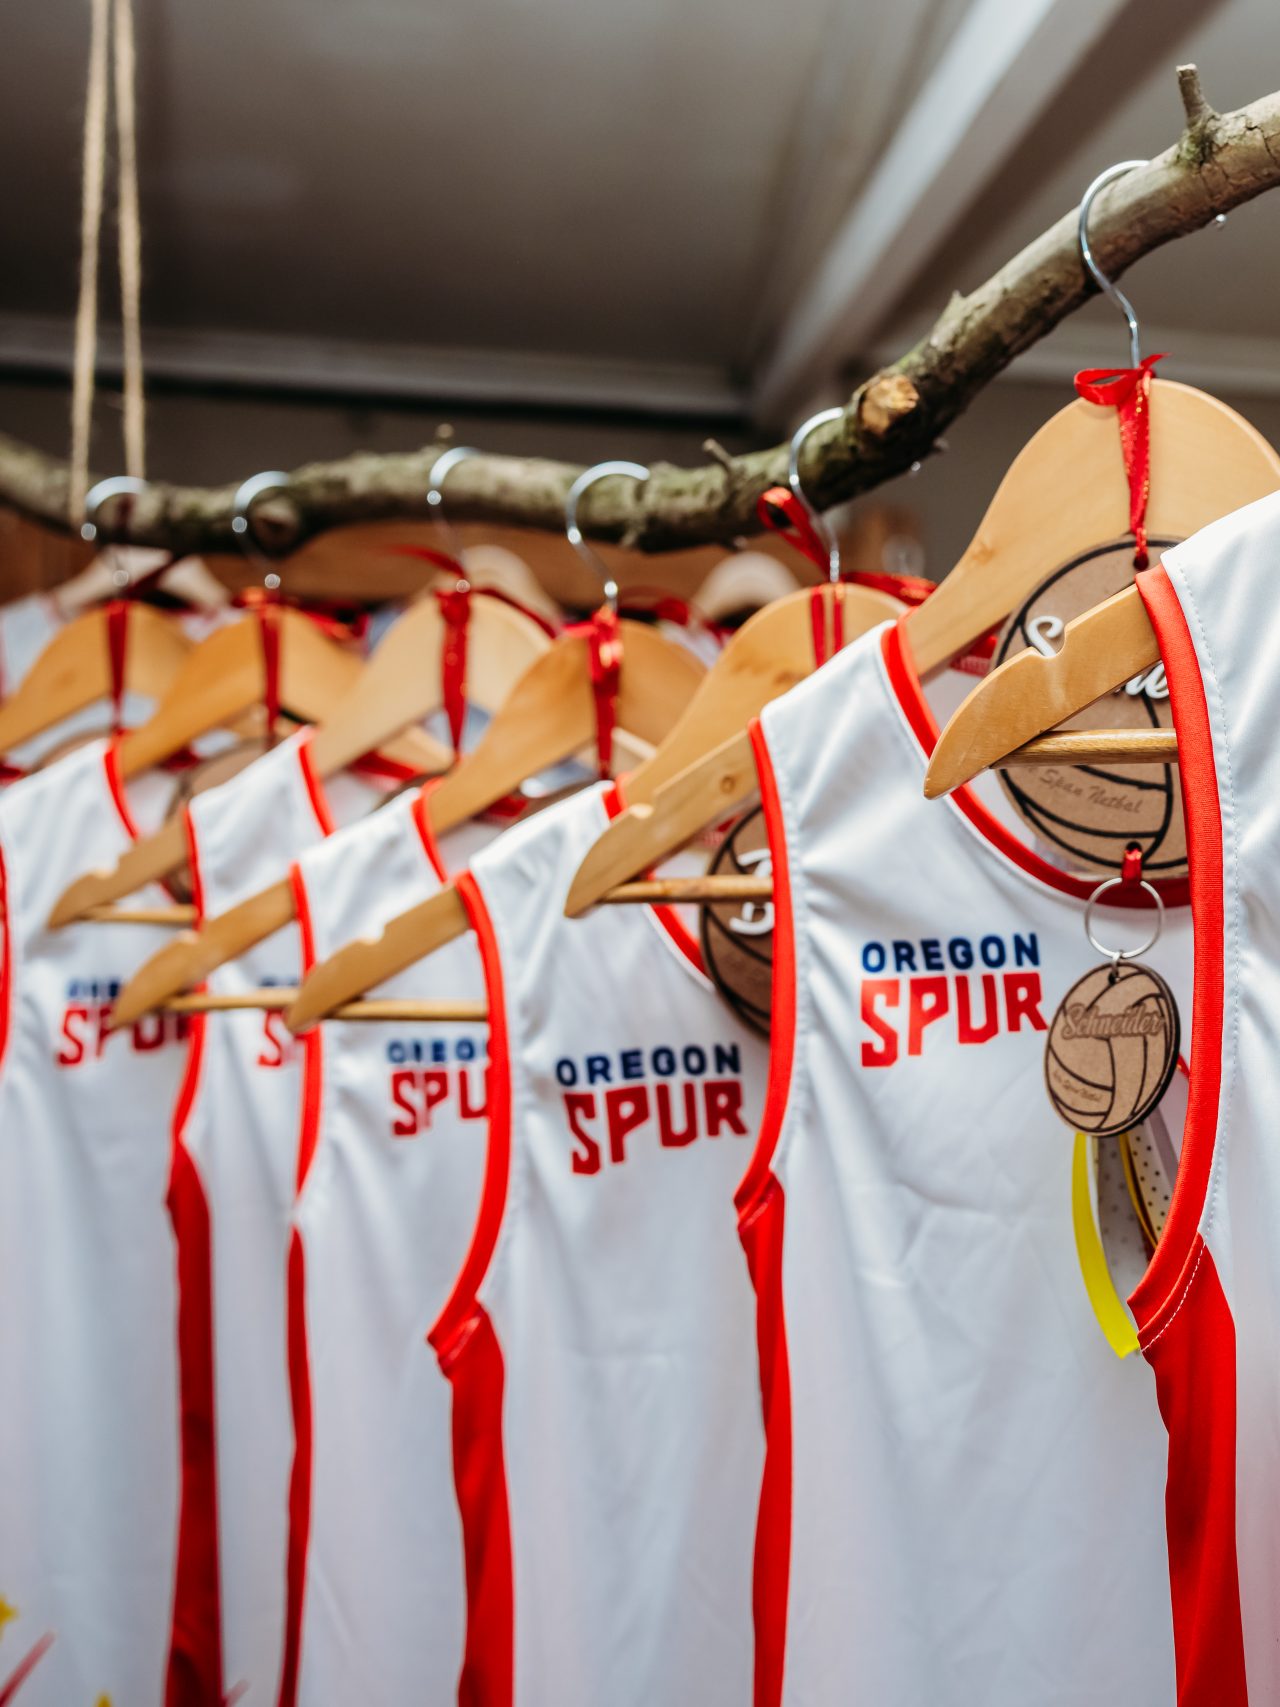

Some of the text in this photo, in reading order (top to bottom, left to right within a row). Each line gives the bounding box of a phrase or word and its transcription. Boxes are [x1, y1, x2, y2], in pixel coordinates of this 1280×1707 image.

[861, 932, 1041, 974] OREGON
[860, 971, 1049, 1068] SPUR
[555, 1042, 742, 1088] OREGON
[391, 1068, 488, 1136] SPU
[562, 1079, 750, 1176] SPUR
